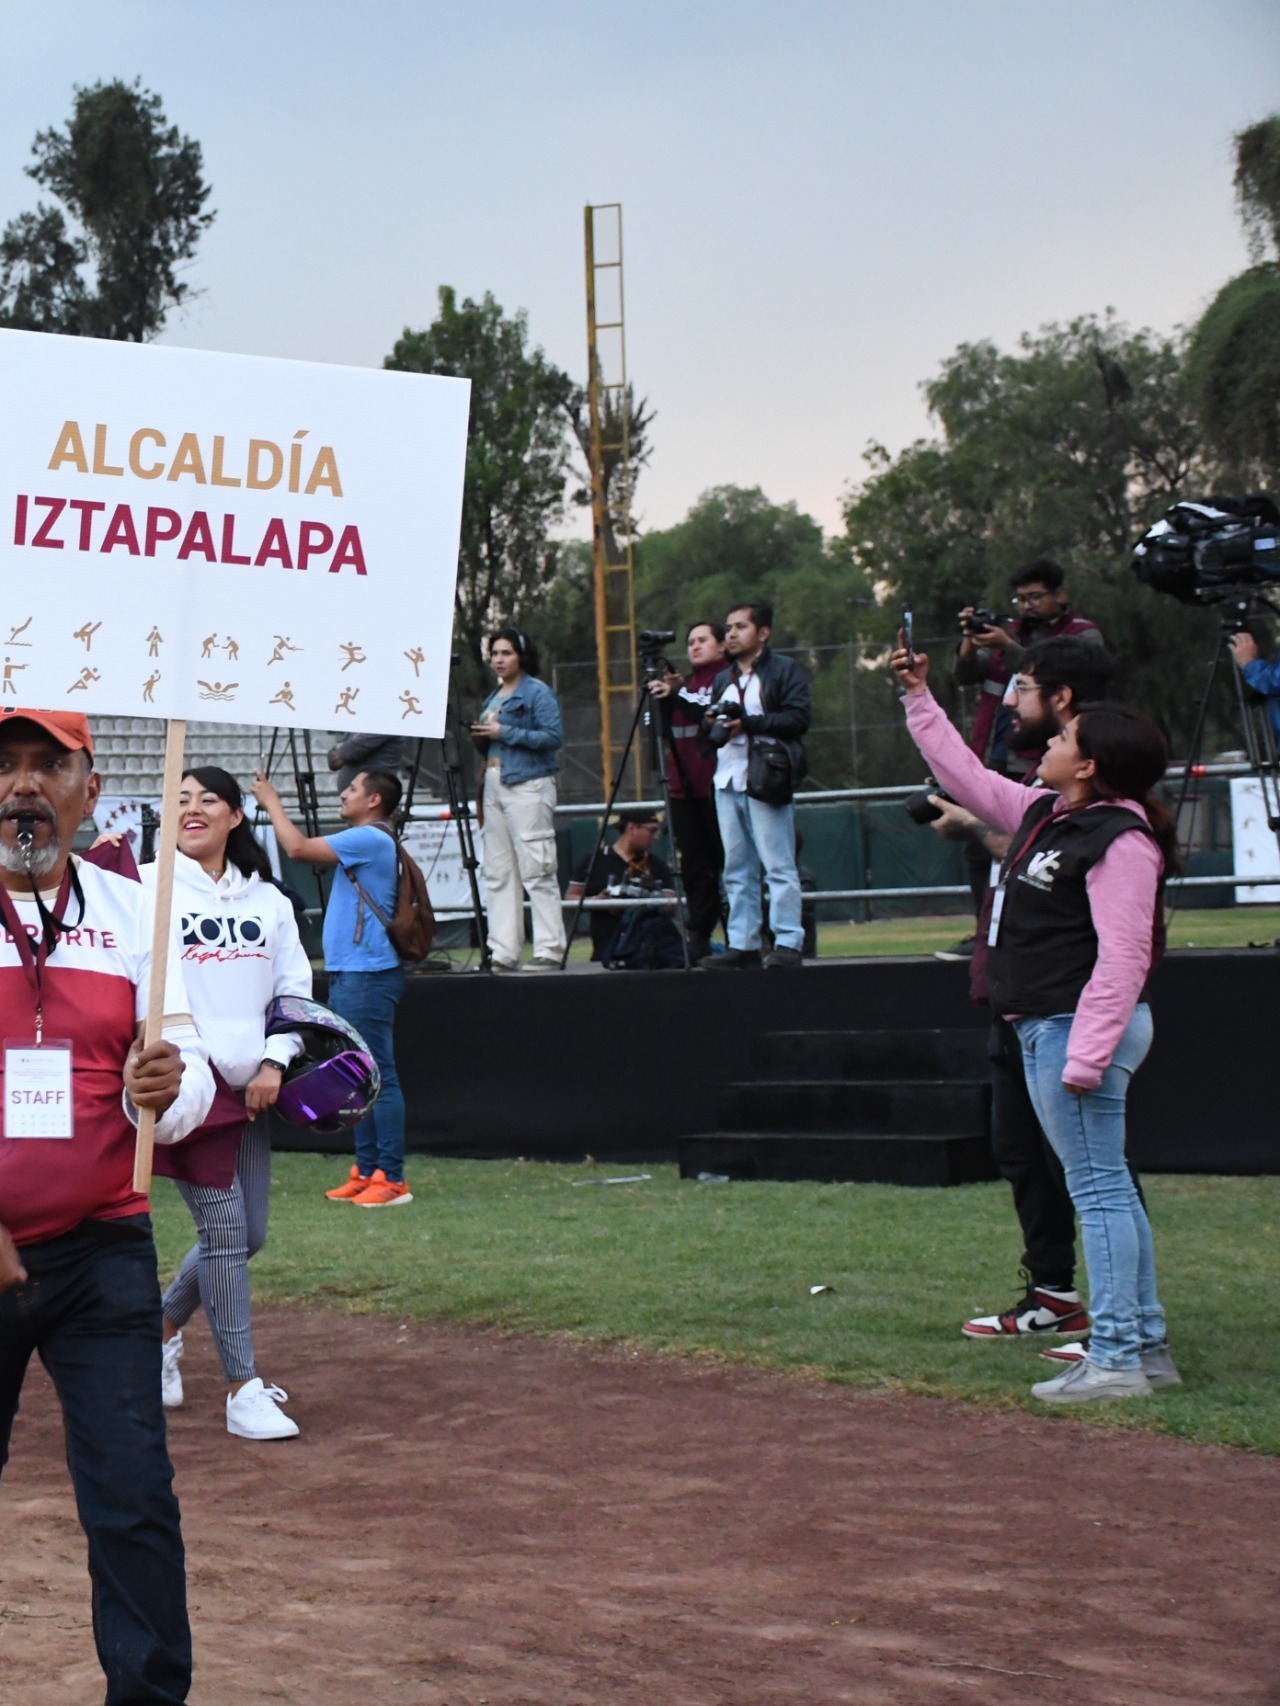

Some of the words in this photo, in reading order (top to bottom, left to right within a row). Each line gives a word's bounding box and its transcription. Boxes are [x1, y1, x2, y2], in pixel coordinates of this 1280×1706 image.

[47, 420, 344, 498] ALCALDÍA
[13, 494, 368, 575] IZTAPALAPA
[181, 912, 266, 949] POLO
[11, 1090, 66, 1105] STAFF
